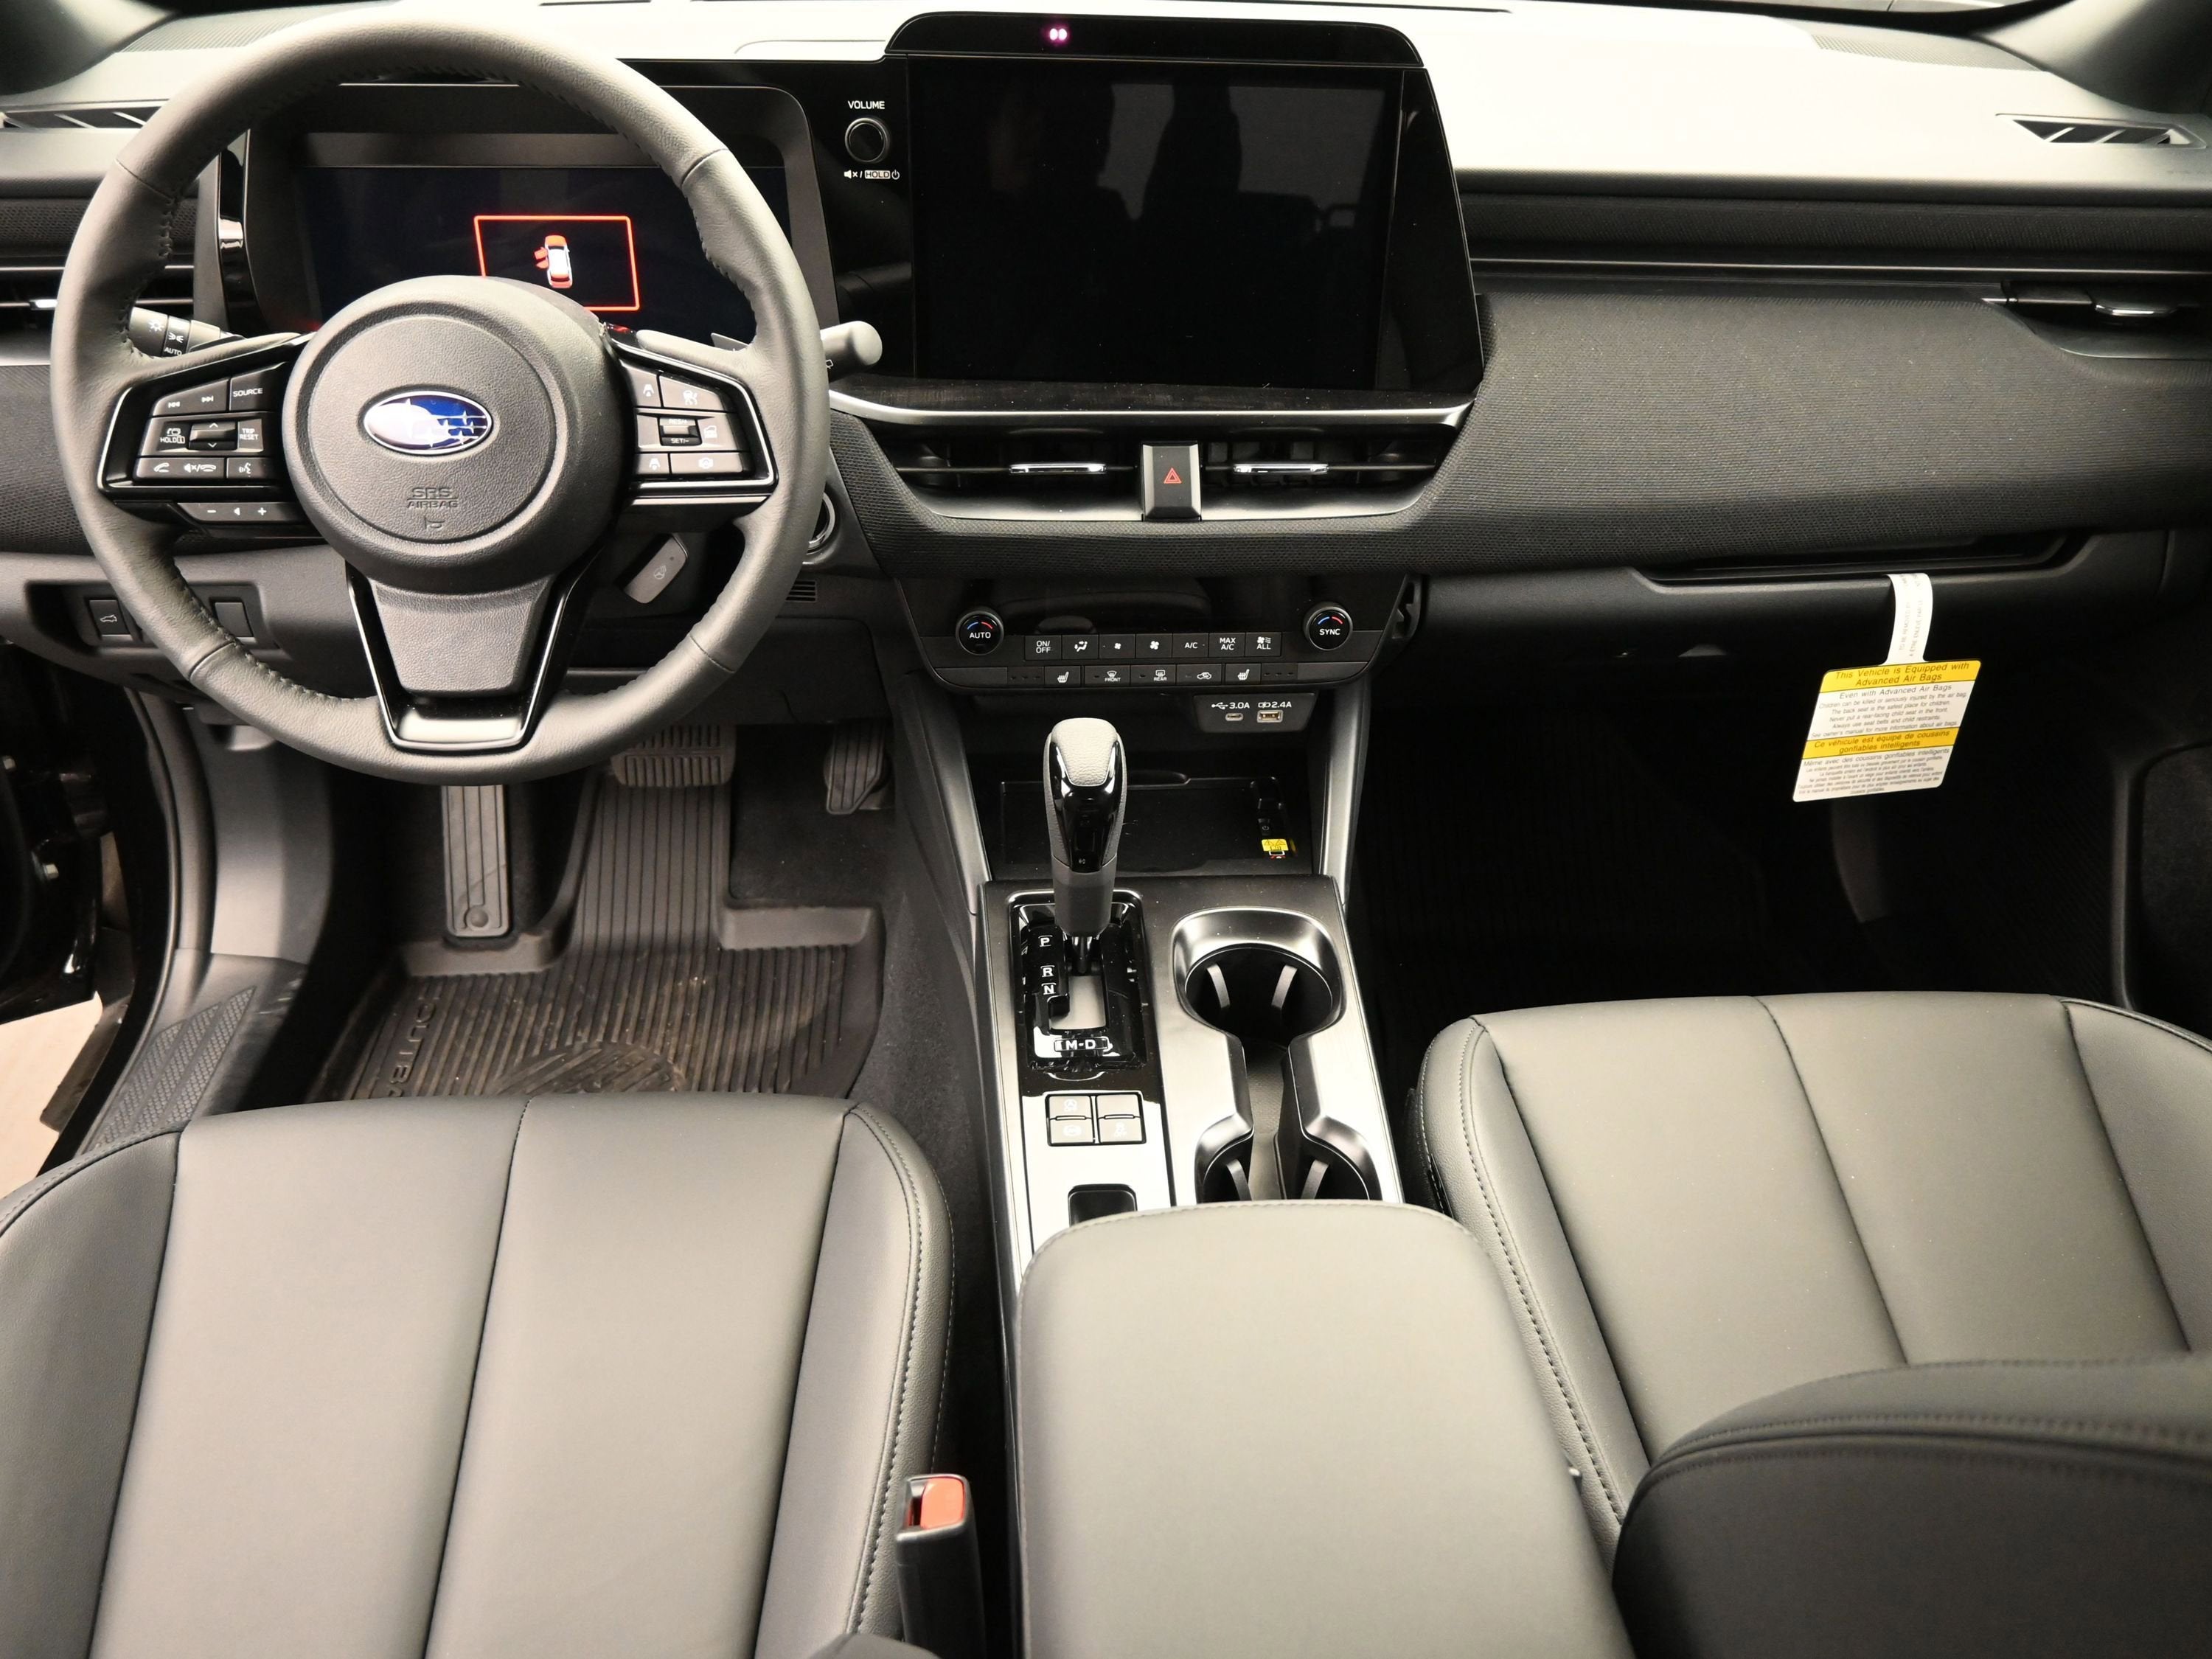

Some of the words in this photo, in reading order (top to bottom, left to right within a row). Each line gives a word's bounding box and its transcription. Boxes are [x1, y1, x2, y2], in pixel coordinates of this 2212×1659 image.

[848, 100, 886, 110] VOLUME
[866, 170, 890, 179] HOLD
[164, 347, 183, 355] AUTO
[233, 388, 263, 397] SOURCE
[411, 487, 453, 498] SRS
[407, 501, 459, 509] AIRBAG
[1318, 627, 1340, 636] SYNC
[1858, 668, 1890, 677] Vehicle
[1905, 663, 1947, 673] Equipped
[1856, 675, 1900, 686] Advanced
[1918, 672, 1941, 684] Bags
[1879, 686, 1916, 695] Advanced
[1839, 744, 1877, 754] gonflables
[1880, 740, 1920, 751] intelligents
[1040, 937, 1050, 946] P
[1043, 967, 1054, 976] R
[1043, 985, 1055, 995] N
